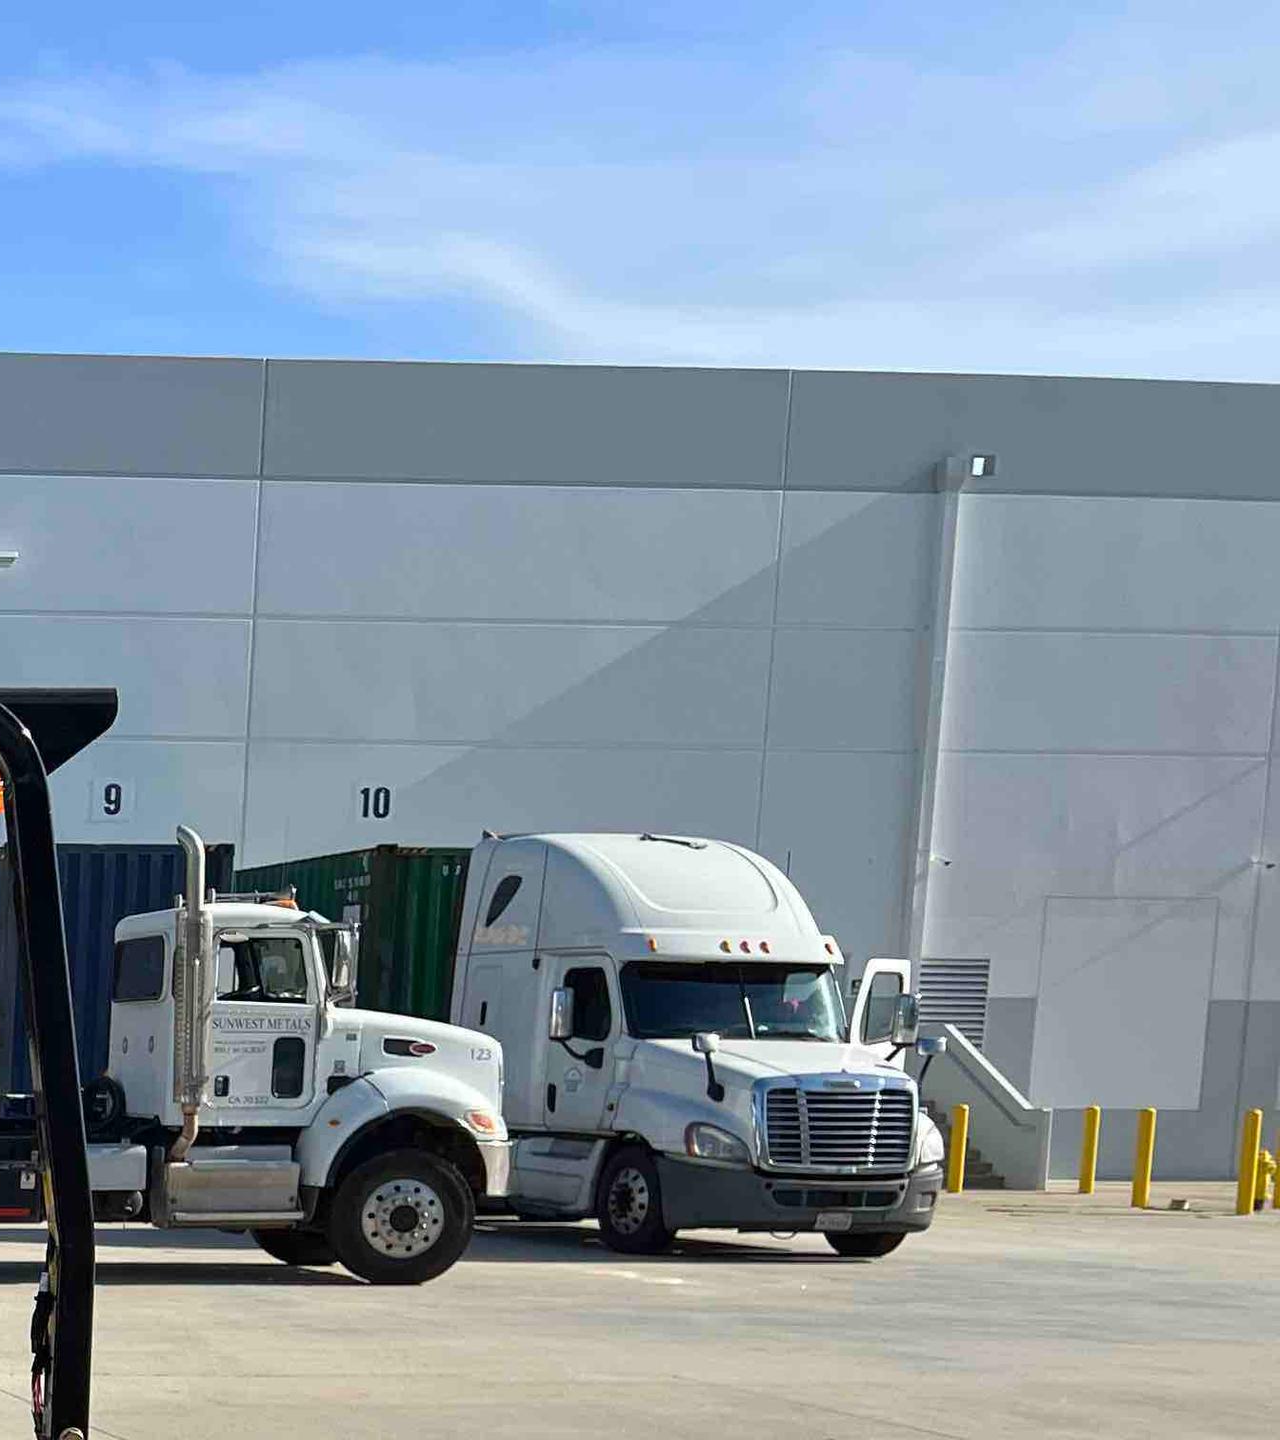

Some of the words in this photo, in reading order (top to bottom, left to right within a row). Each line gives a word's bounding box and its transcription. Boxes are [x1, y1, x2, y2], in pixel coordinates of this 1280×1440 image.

[103, 783, 122, 816] 9
[360, 786, 391, 819] 10
[211, 1018, 266, 1030] SUNWEST
[267, 1018, 311, 1031] METALS
[469, 1048, 492, 1061] 123
